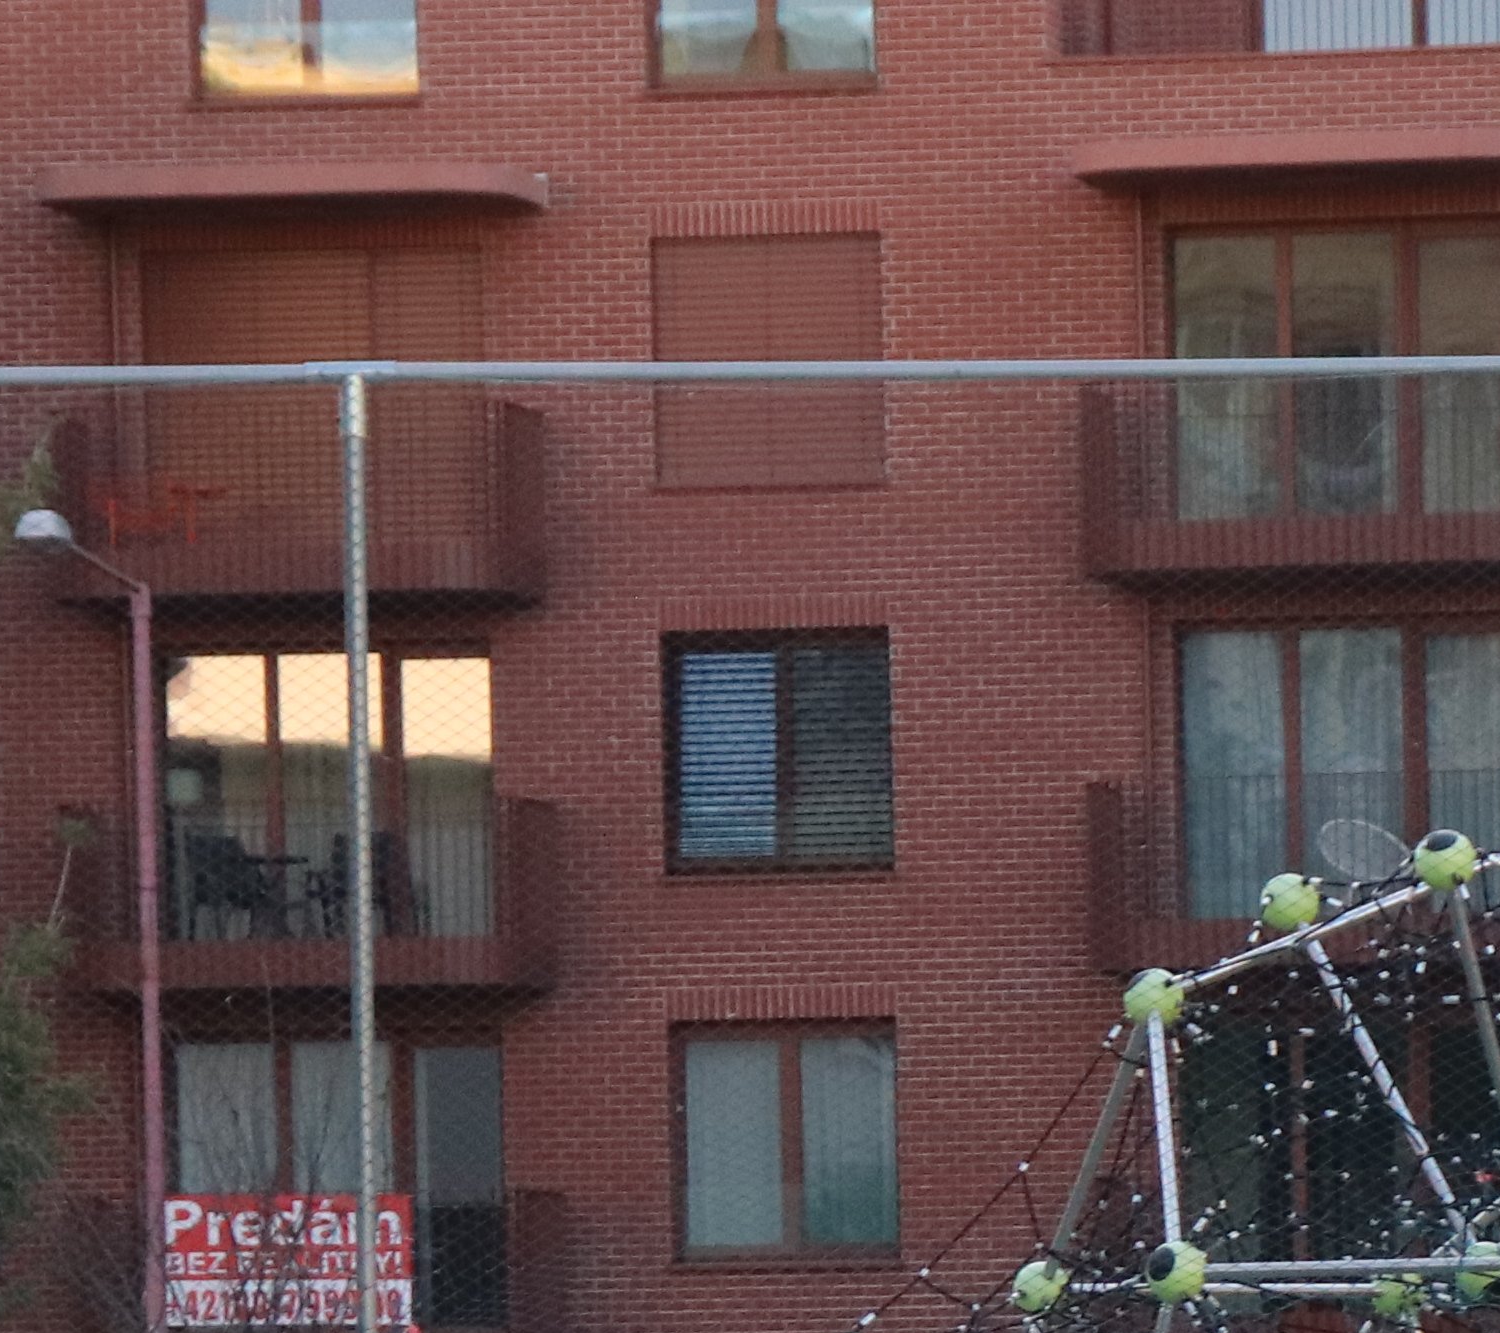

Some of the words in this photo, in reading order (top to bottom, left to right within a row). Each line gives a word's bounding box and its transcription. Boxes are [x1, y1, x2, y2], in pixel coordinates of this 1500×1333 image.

[164, 1199, 402, 1246] Predám
[165, 1252, 227, 1274] BEZ
[237, 1252, 400, 1274] REALITY!
